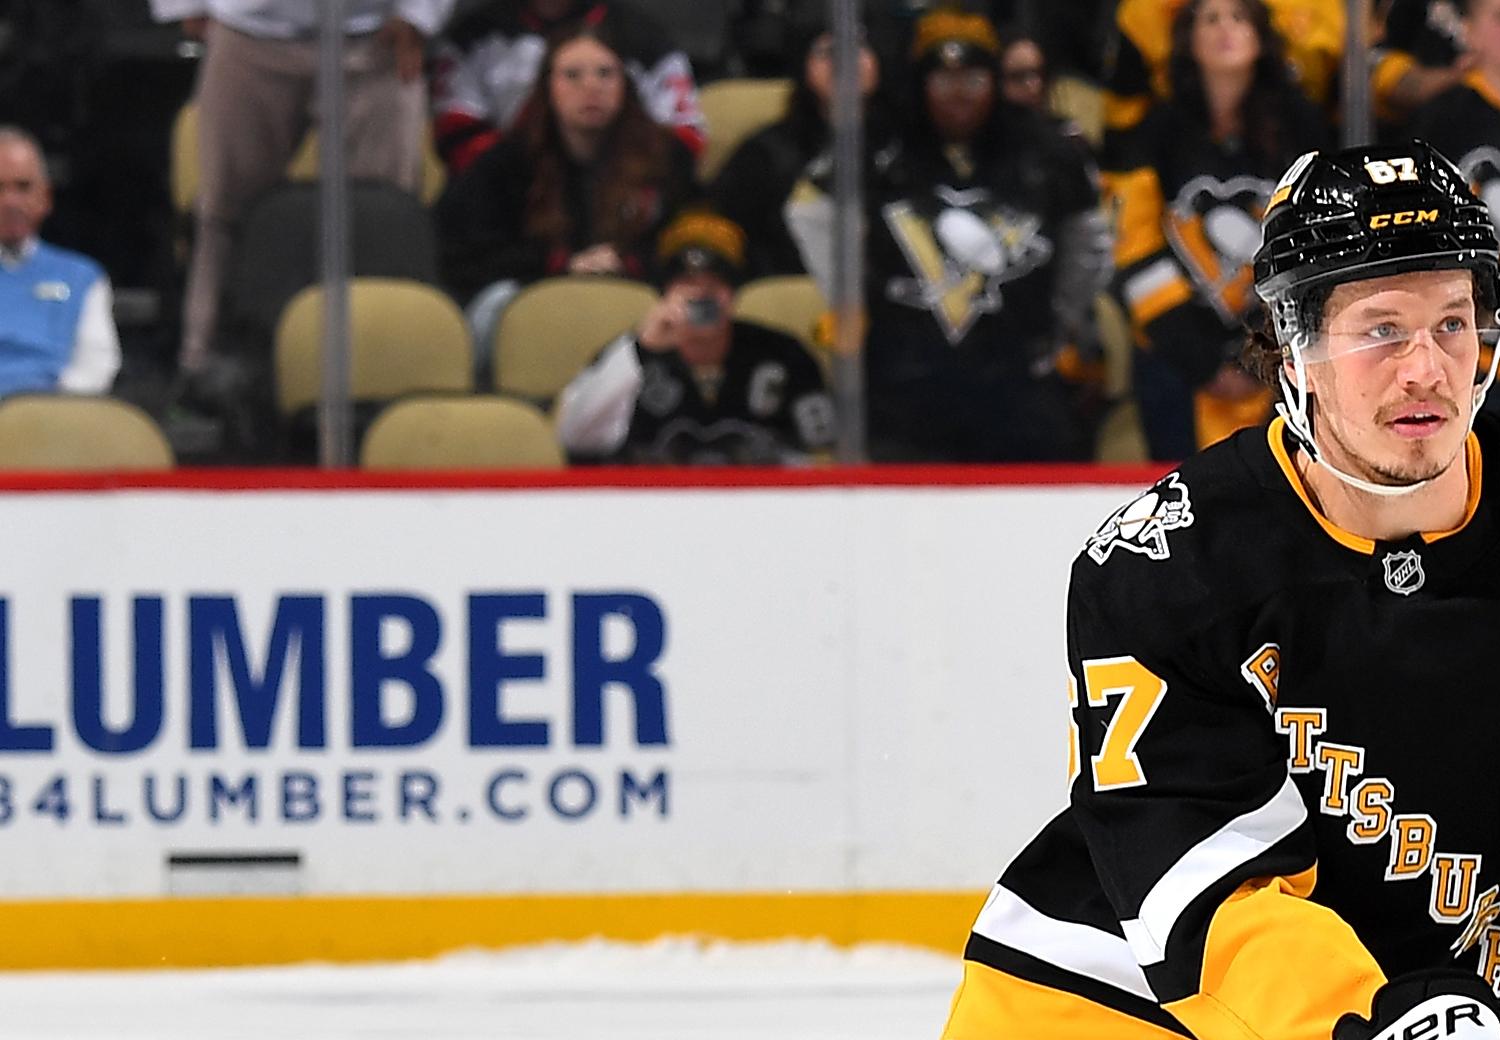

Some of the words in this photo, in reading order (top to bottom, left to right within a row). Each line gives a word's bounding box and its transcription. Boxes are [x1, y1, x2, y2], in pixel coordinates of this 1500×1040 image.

[1369, 209, 1440, 230] CCM
[0, 592, 672, 753] LUMBER
[1068, 655, 1169, 793] 7
